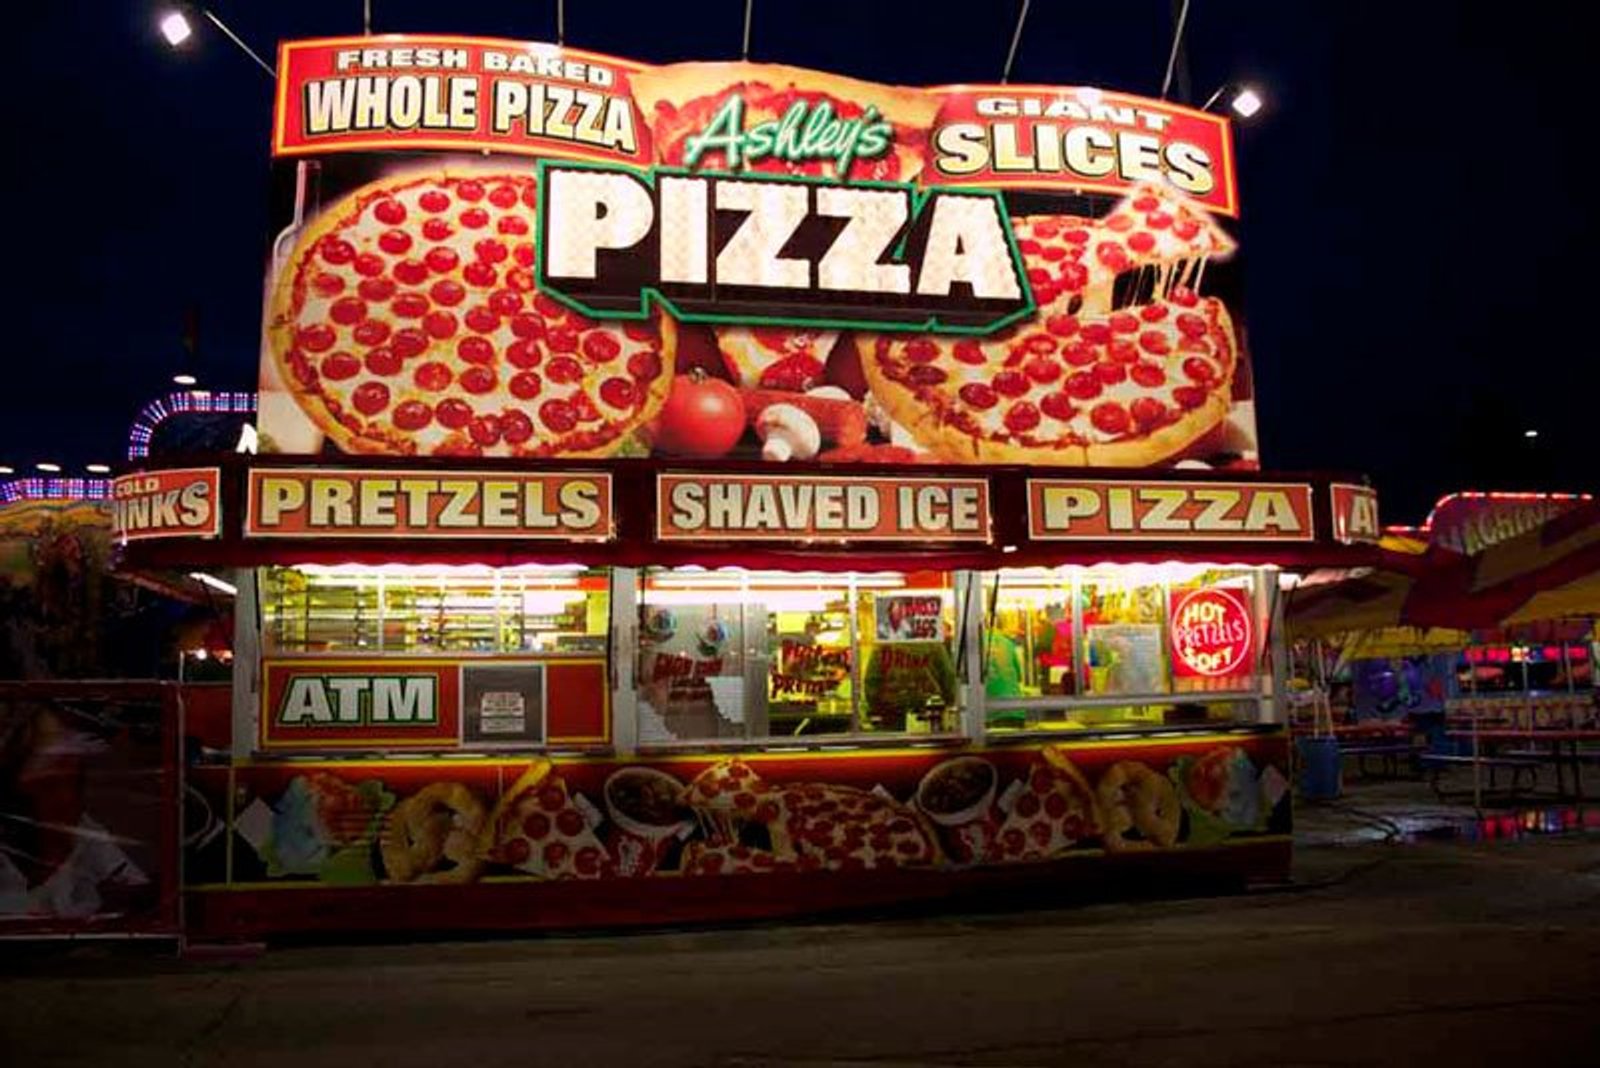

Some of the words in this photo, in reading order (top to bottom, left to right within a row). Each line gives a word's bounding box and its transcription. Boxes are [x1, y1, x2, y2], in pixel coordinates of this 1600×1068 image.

[337, 48, 468, 71] FRESH
[483, 51, 614, 87] BAKED
[305, 76, 478, 136] WHOLE
[491, 79, 636, 153] PIZZA
[684, 93, 893, 181] Ashley's
[975, 95, 1173, 130] GIANT
[935, 124, 1216, 196] SLICES
[546, 167, 1024, 301] PIZZA
[260, 478, 602, 529] PRETZELS
[670, 482, 882, 532] SHAVED
[898, 486, 981, 532] ICE
[1043, 487, 1303, 532] PIZZA
[1183, 601, 1227, 629] HOT
[280, 675, 437, 724] ATM
